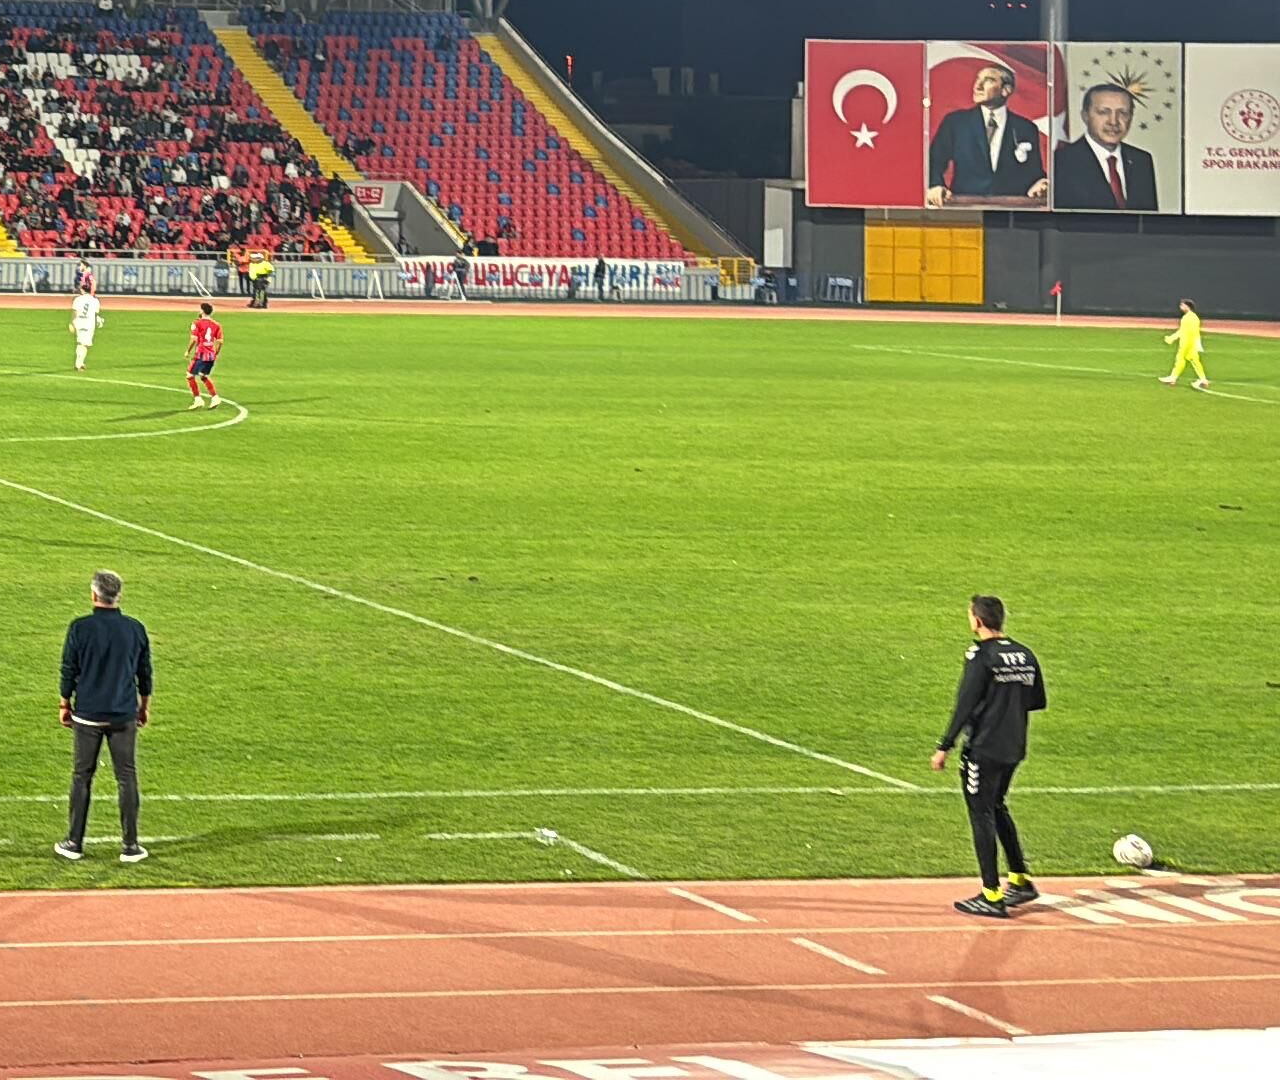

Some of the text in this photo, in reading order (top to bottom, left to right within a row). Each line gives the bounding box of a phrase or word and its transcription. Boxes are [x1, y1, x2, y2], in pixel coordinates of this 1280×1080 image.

[1206, 147, 1227, 157] T.C.
[1202, 159, 1234, 169] SPOR
[997, 652, 1027, 666] TFF
